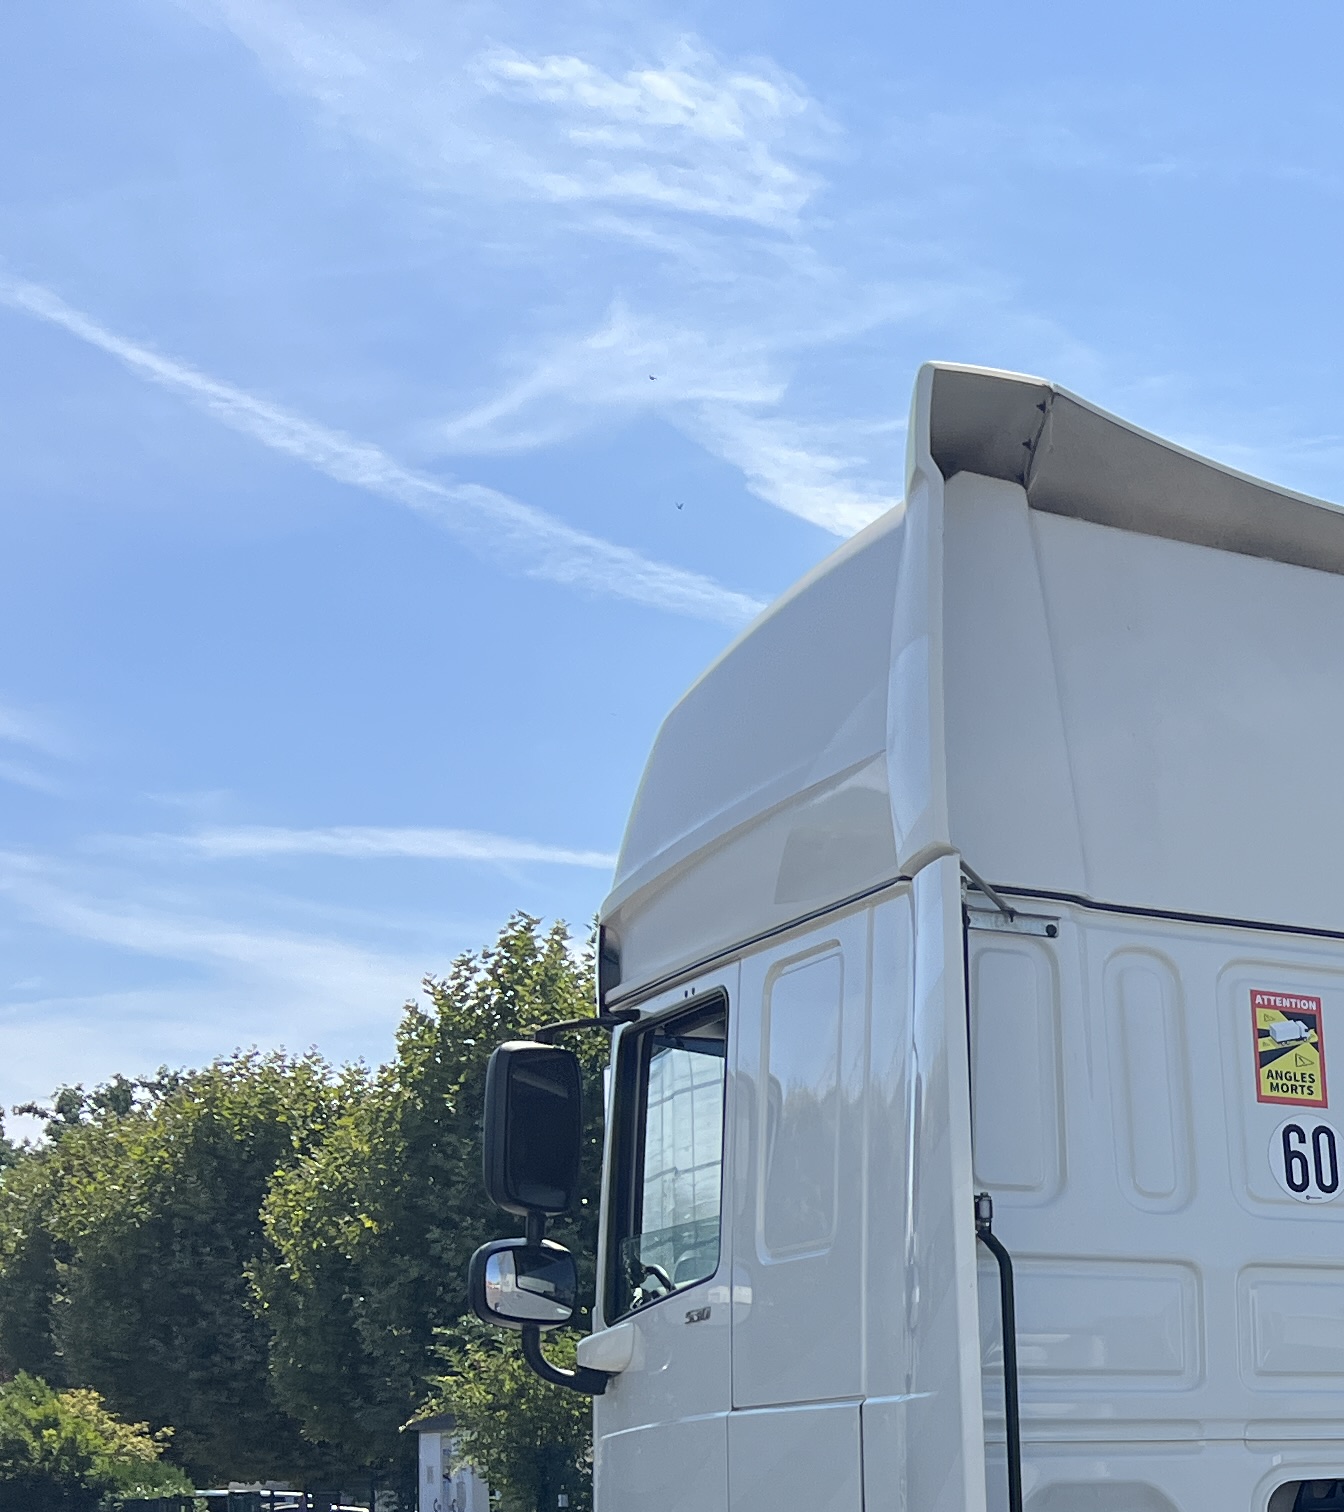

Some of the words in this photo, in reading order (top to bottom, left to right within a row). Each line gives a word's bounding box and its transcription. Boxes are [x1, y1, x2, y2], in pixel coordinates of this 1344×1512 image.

[1255, 994, 1317, 1010] ATTENTION
[1266, 1069, 1316, 1083] ANGLES
[1269, 1082, 1315, 1096] MORTS
[1282, 1124, 1339, 1193] 60
